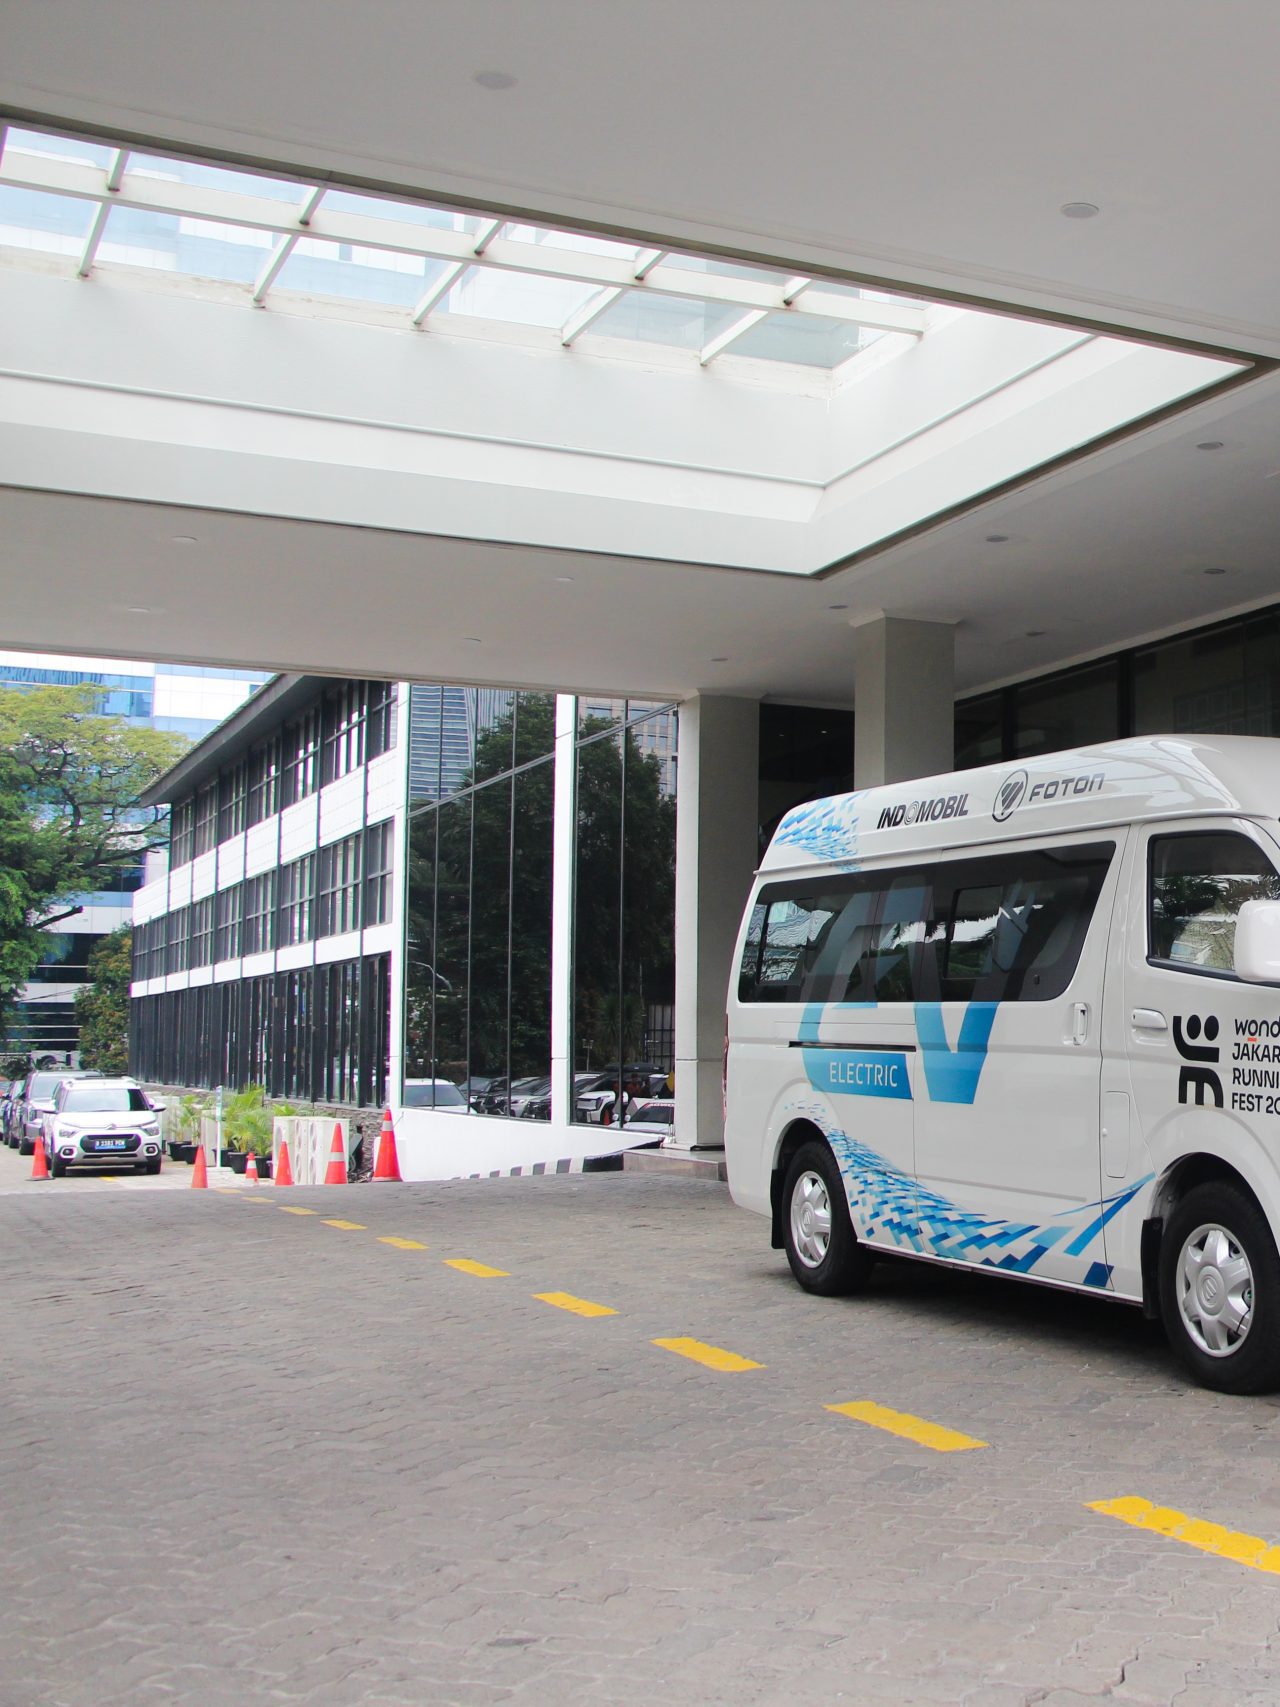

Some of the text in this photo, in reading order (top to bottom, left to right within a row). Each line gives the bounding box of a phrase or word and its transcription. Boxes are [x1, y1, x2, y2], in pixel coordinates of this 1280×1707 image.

[1029, 772, 1105, 802] FOTON
[877, 793, 970, 829] INDOMOBIL
[829, 1061, 898, 1088] ELECTRIC
[1232, 1092, 1263, 1113] FEST
